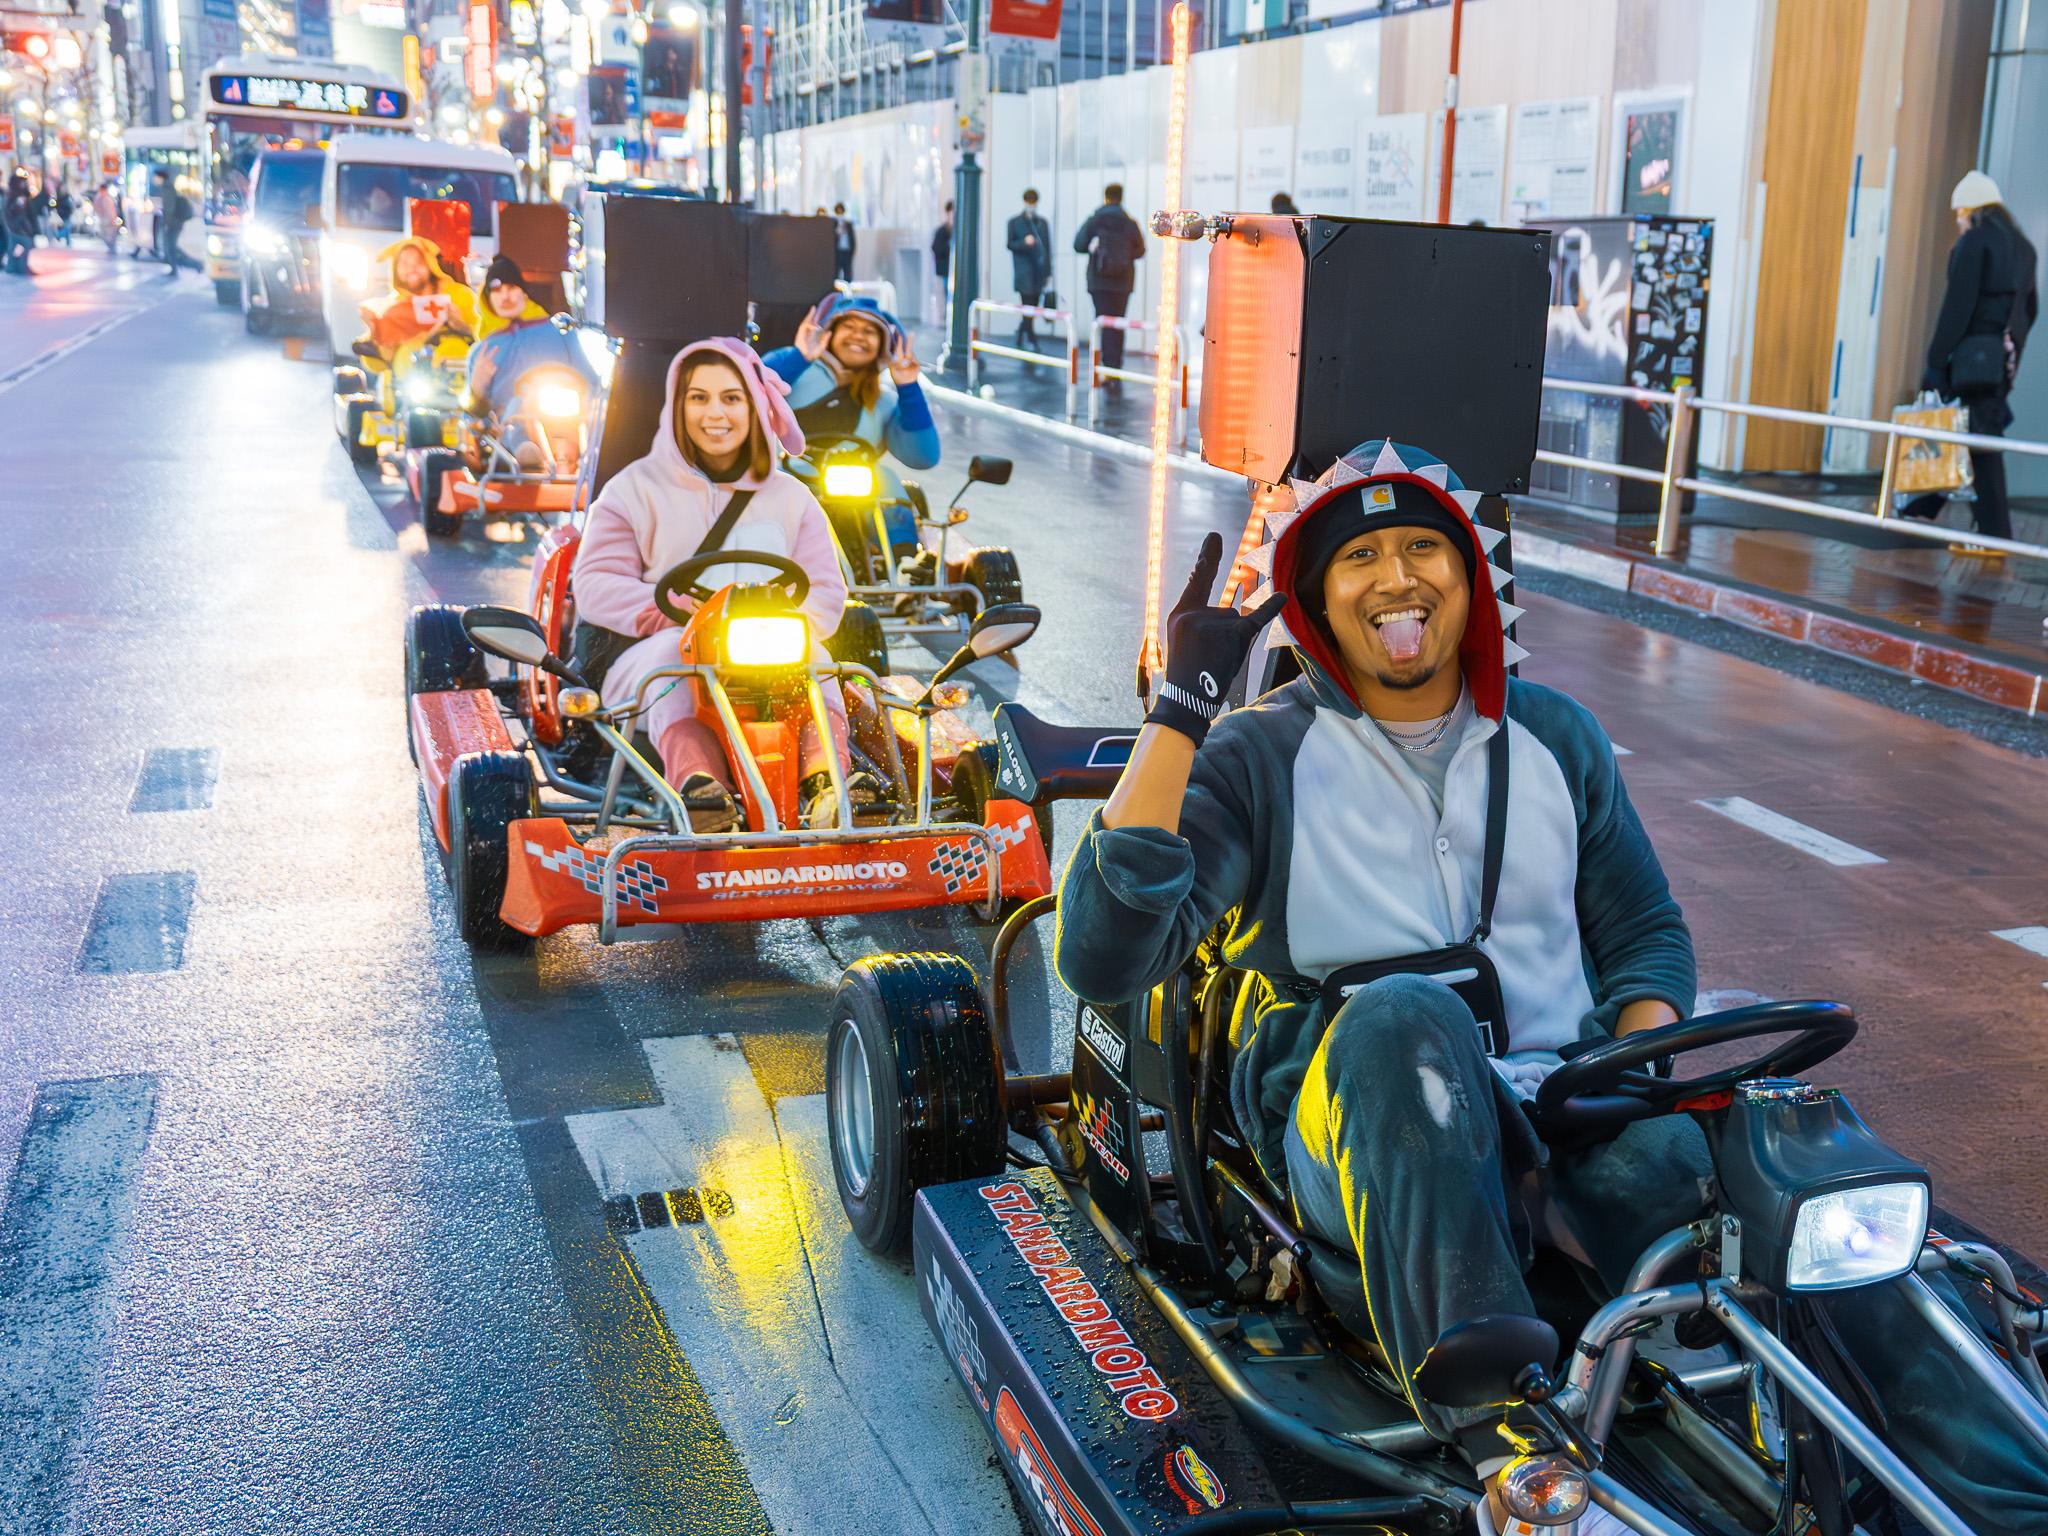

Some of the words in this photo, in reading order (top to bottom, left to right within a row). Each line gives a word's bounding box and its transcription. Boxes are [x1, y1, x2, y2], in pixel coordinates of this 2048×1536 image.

[1001, 731, 1027, 792] MALOSSI
[696, 861, 908, 890] STANDARDMOTO
[1090, 1017, 1124, 1068] Castrol
[978, 1182, 1179, 1420] STANDARDMOTO
